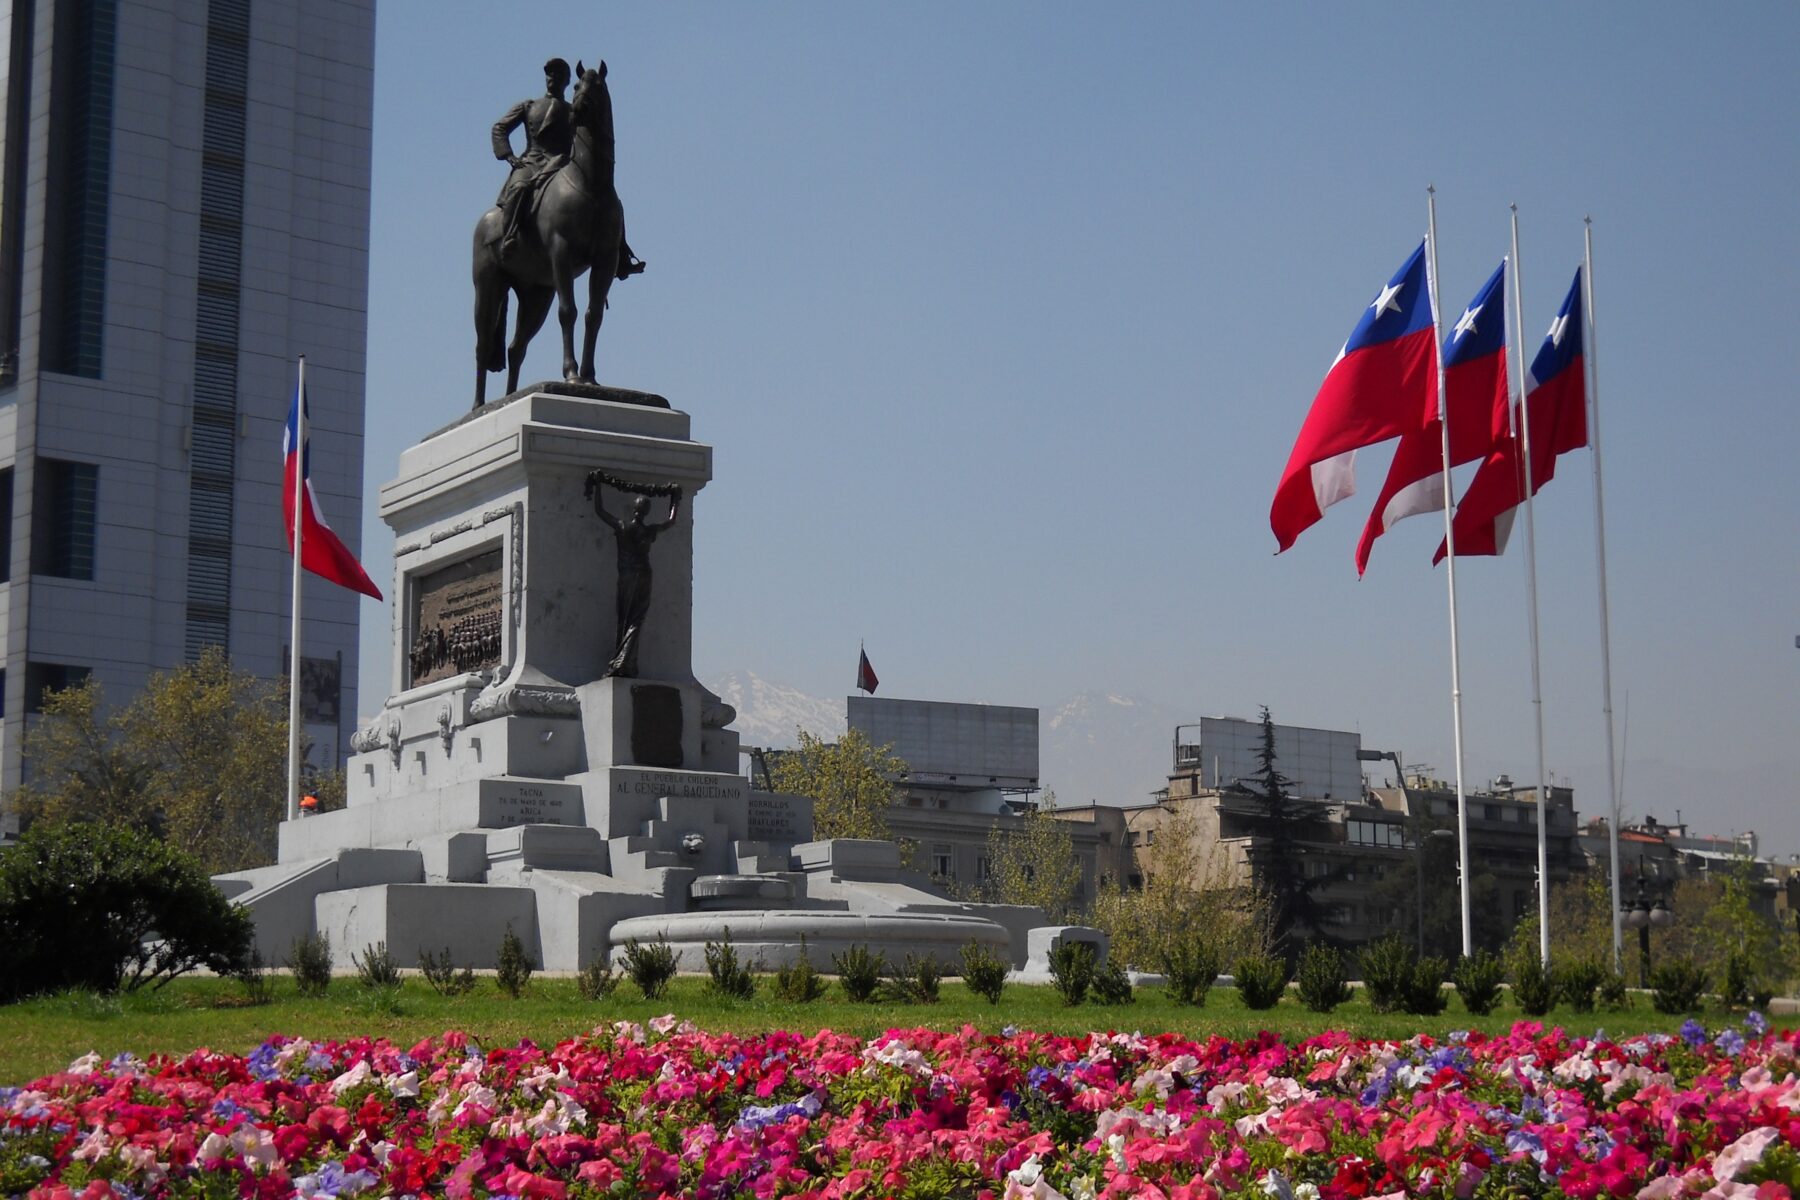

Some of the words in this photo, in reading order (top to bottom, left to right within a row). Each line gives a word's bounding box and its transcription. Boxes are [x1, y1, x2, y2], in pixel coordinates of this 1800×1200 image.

[654, 773, 684, 783] PUEBLO
[687, 775, 719, 785] CHILENO
[519, 788, 543, 797] TACNA
[617, 781, 630, 794] AL
[634, 782, 680, 797] GENERAL
[683, 784, 741, 800] BAQUEDANO
[748, 800, 790, 809] HORRILLOS
